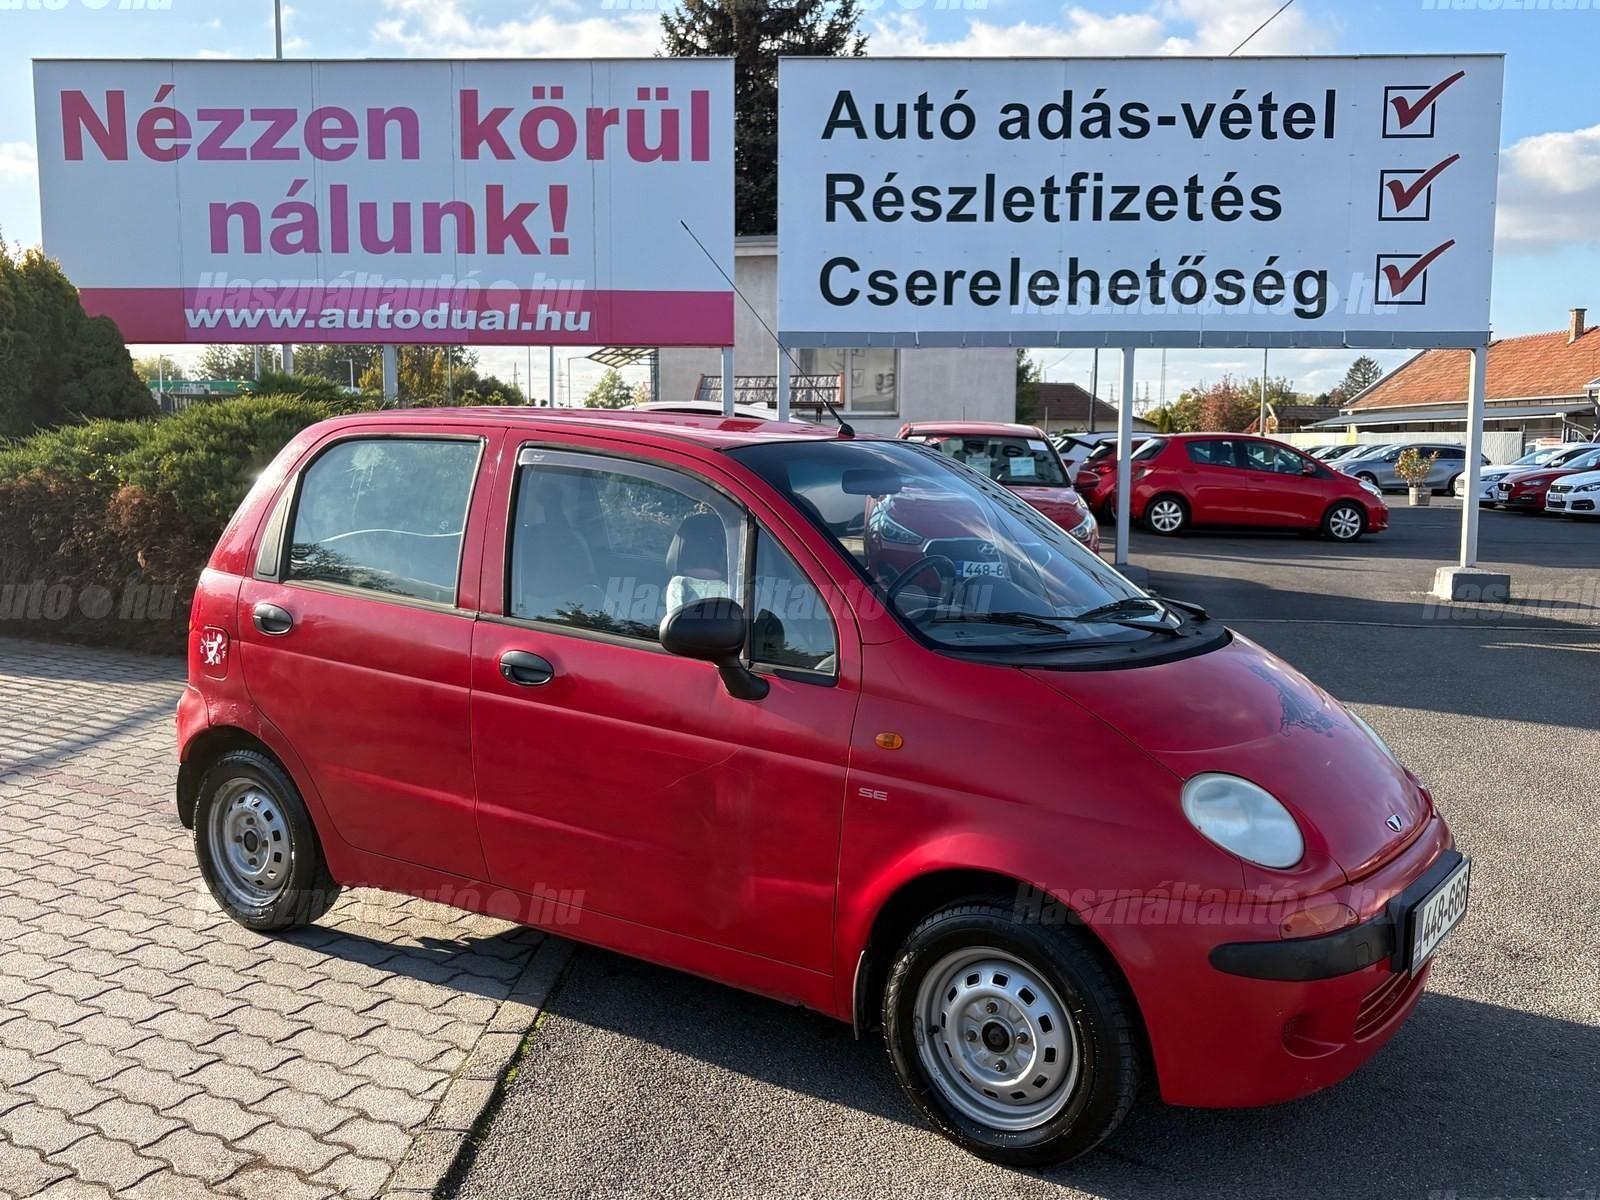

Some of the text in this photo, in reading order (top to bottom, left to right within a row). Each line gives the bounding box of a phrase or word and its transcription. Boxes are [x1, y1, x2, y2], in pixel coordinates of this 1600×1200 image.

[60, 84, 711, 162] Nézzen körül
[820, 88, 1337, 141] Autó adás-vétel
[209, 179, 571, 256] nálunk!
[825, 171, 1283, 223] Részletfizetés
[819, 255, 1329, 320] Cserelehetőség
[184, 302, 591, 332] www.autodual.hu
[858, 787, 888, 801] SE
